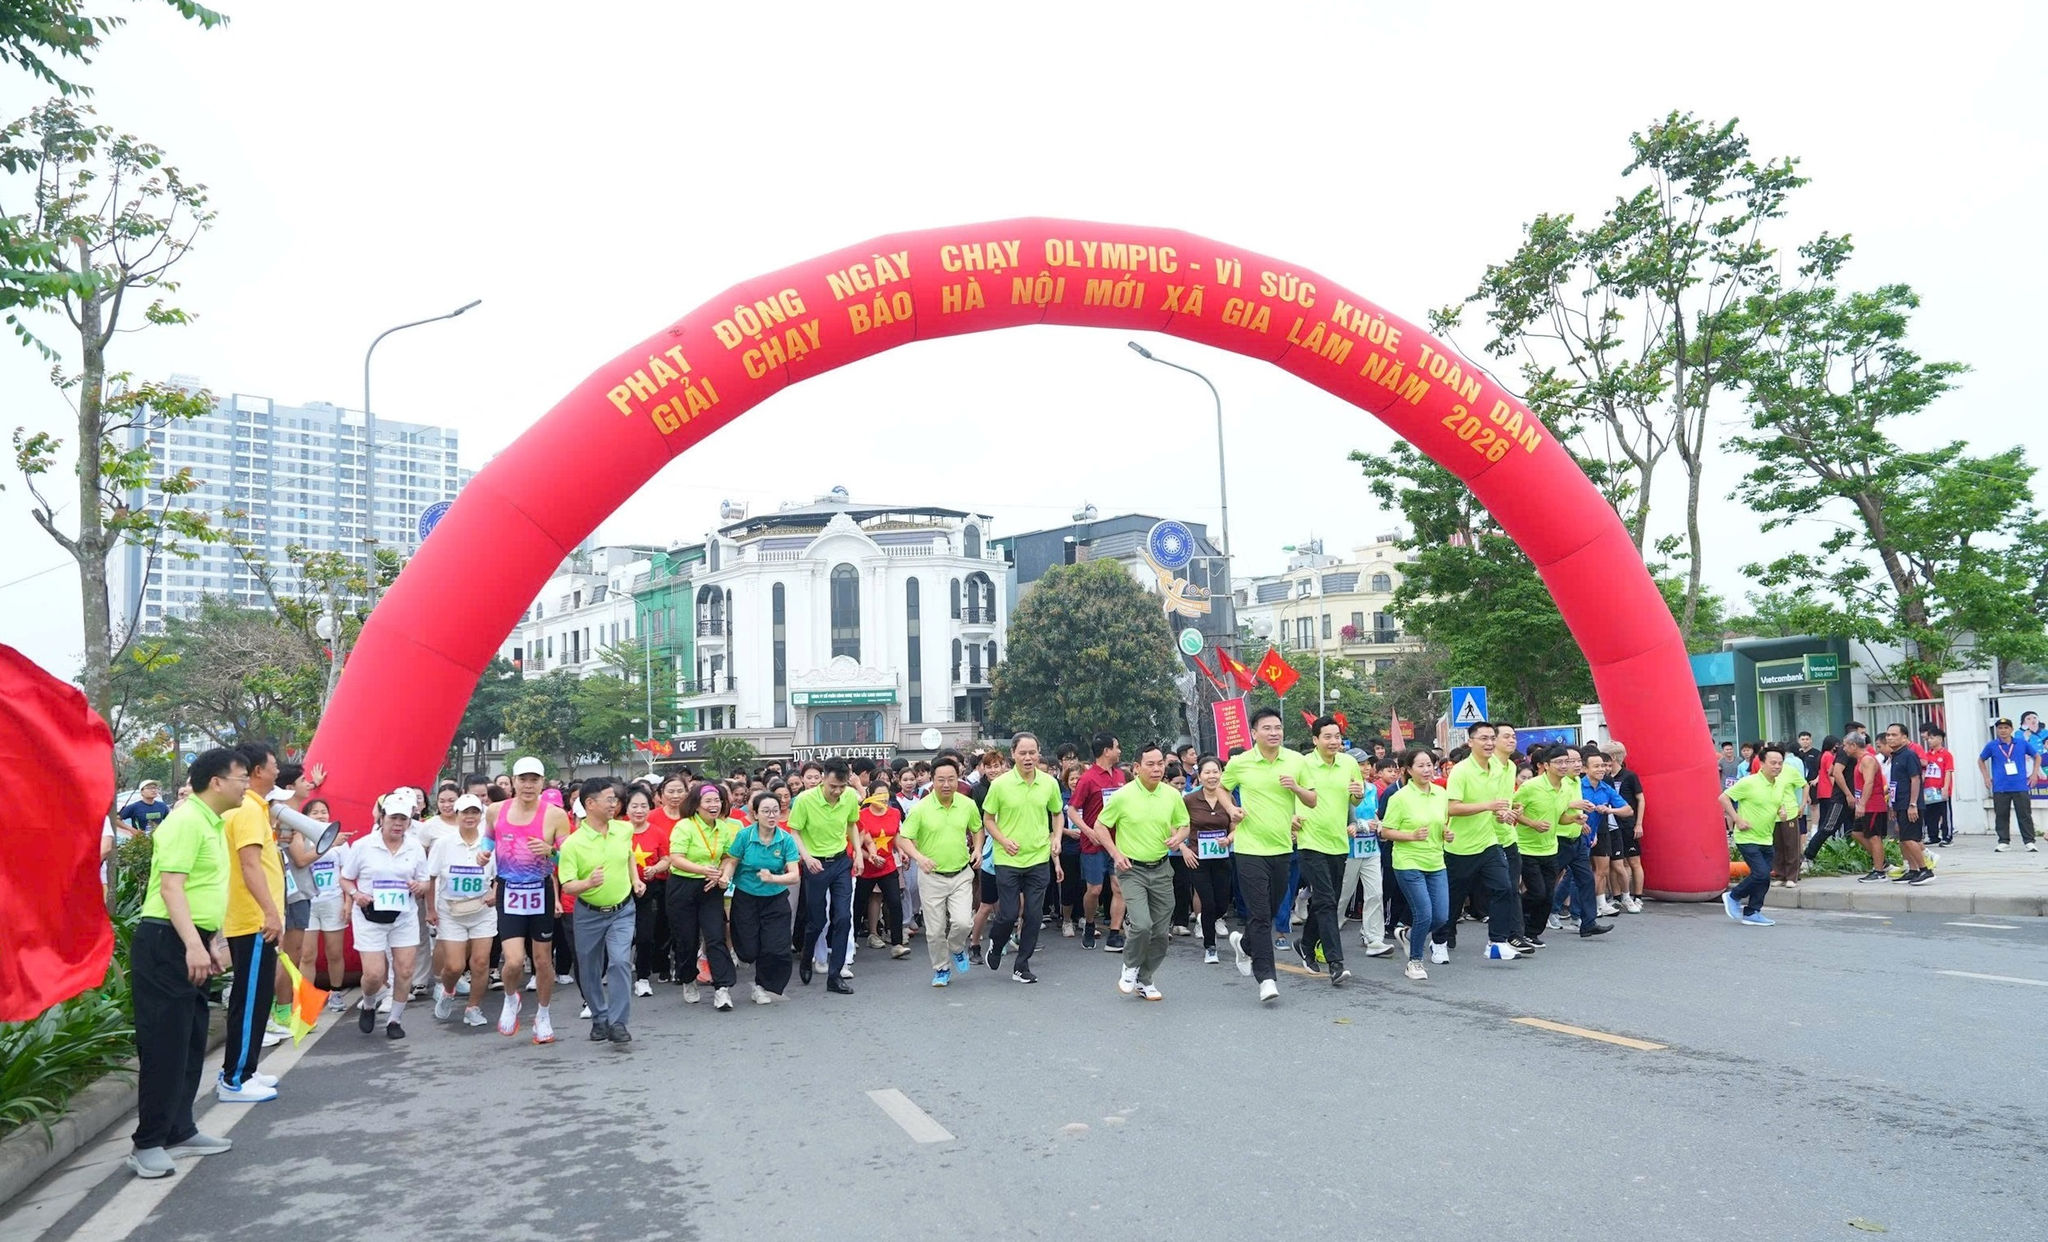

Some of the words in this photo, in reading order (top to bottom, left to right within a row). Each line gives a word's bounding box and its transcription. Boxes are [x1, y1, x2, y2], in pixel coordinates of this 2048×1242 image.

[606, 345, 692, 416] PHÁT
[711, 288, 807, 350] ĐỘNG
[826, 251, 911, 300] NGÀY
[940, 240, 1021, 274] CHẠY
[1045, 238, 1178, 274] OLYMPIC
[1215, 258, 1243, 288] VÌ
[1260, 271, 1317, 309] SỨC
[1331, 300, 1402, 354] KHỎE
[1418, 343, 1482, 404] TOÀN
[1489, 398, 1543, 454] DÂN
[651, 376, 721, 436] GIẢI
[741, 319, 823, 380] CHẠY
[848, 291, 914, 335] BÁO
[941, 277, 986, 314] HÀ
[1011, 270, 1066, 308] NỘI
[1083, 271, 1145, 309] MỚI
[1160, 283, 1204, 318] XÃ
[1221, 297, 1272, 334] GIA
[1286, 317, 1354, 366] LÂM
[1359, 353, 1432, 406] NĂM
[1440, 403, 1511, 464] 2026
[1760, 673, 1804, 684] Vietcombank
[679, 740, 697, 752] CAFE
[793, 747, 816, 762] DUY
[846, 747, 891, 760] COFFEE
[452, 877, 482, 892] 168
[379, 892, 406, 906] 171
[508, 892, 541, 910] 215
